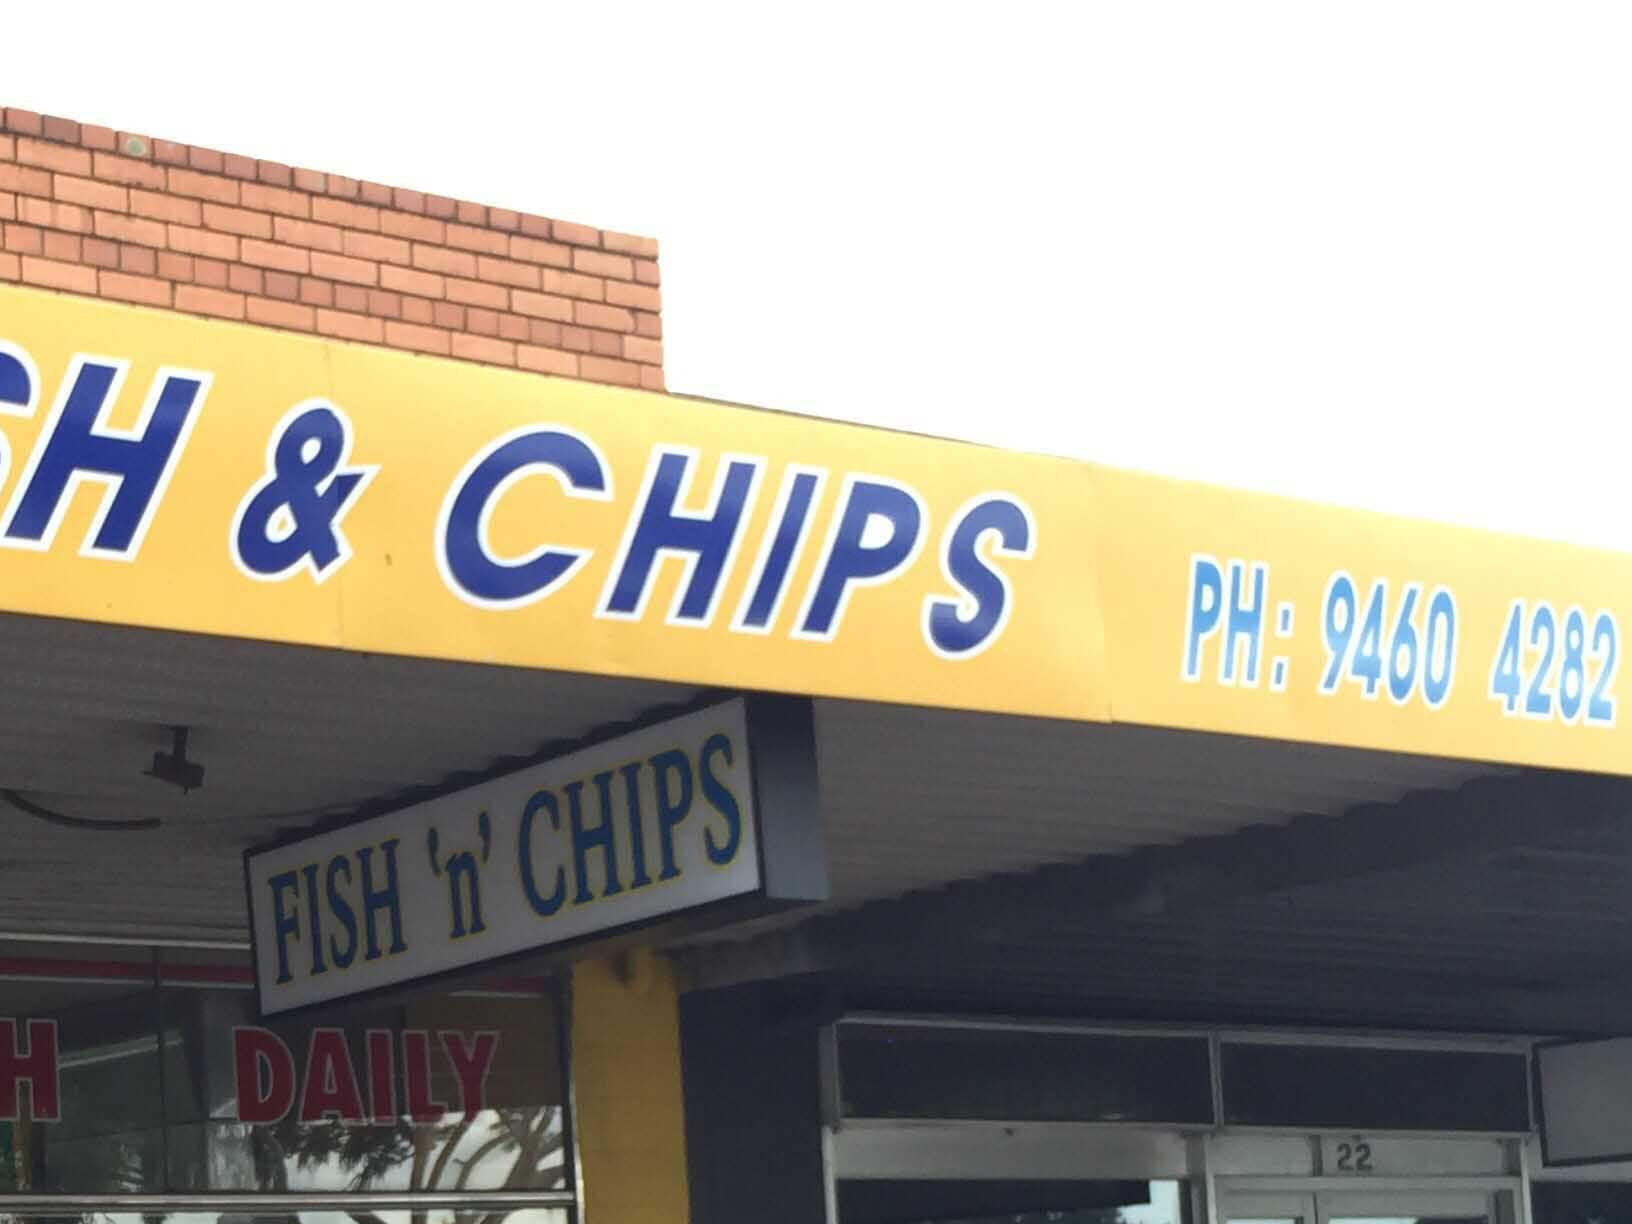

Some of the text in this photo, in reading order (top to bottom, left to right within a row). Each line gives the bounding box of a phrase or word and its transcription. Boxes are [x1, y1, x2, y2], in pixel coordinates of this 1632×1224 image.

[229, 398, 382, 585] &
[434, 423, 1036, 660] CHIPS
[1180, 553, 1621, 728] PH: 9460 4282
[268, 733, 743, 985] FISH 'n' CHIPS
[233, 1025, 500, 1127] DAILY
[1336, 1143, 1373, 1171] 22
